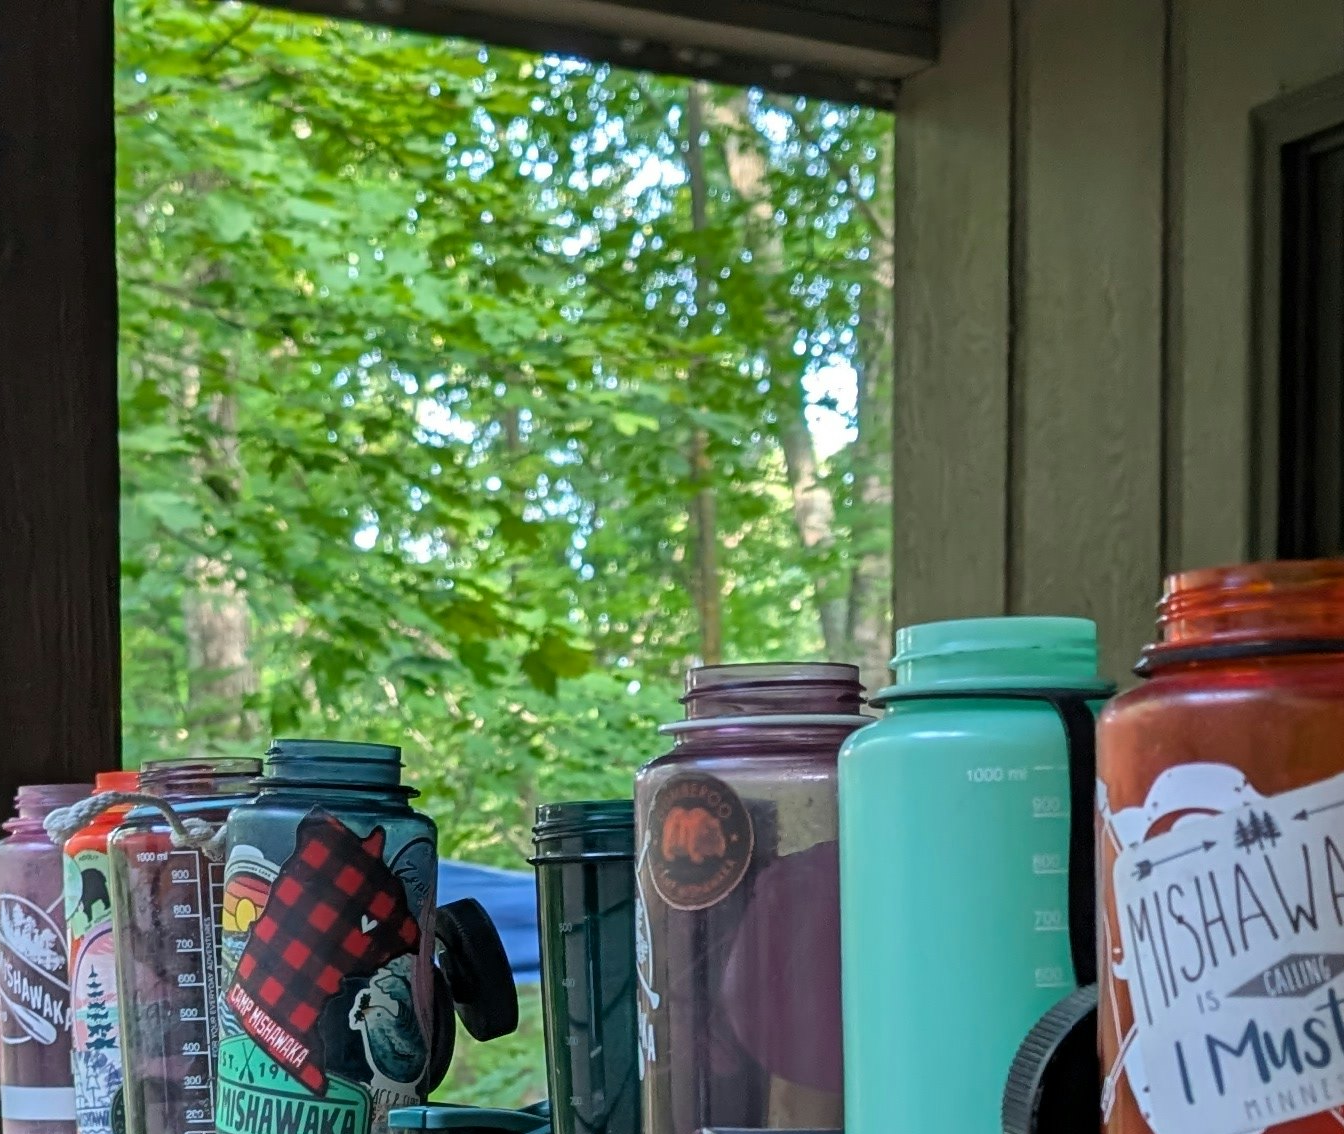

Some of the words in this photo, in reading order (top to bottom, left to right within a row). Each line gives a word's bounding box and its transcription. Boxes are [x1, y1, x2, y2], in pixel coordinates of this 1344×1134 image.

[967, 768, 1003, 782] 1000
[171, 869, 190, 880] 900
[1034, 910, 1061, 926] 700
[175, 939, 194, 949] 700
[1196, 993, 1221, 1014] IS
[1262, 955, 1333, 996] CALLING
[179, 1008, 198, 1018] 500
[230, 983, 251, 1016] CAMP
[248, 1007, 310, 1068] MISHAWAKA
[182, 1042, 200, 1052] 400
[1174, 1040, 1196, 1105] I
[183, 1076, 202, 1086] 300
